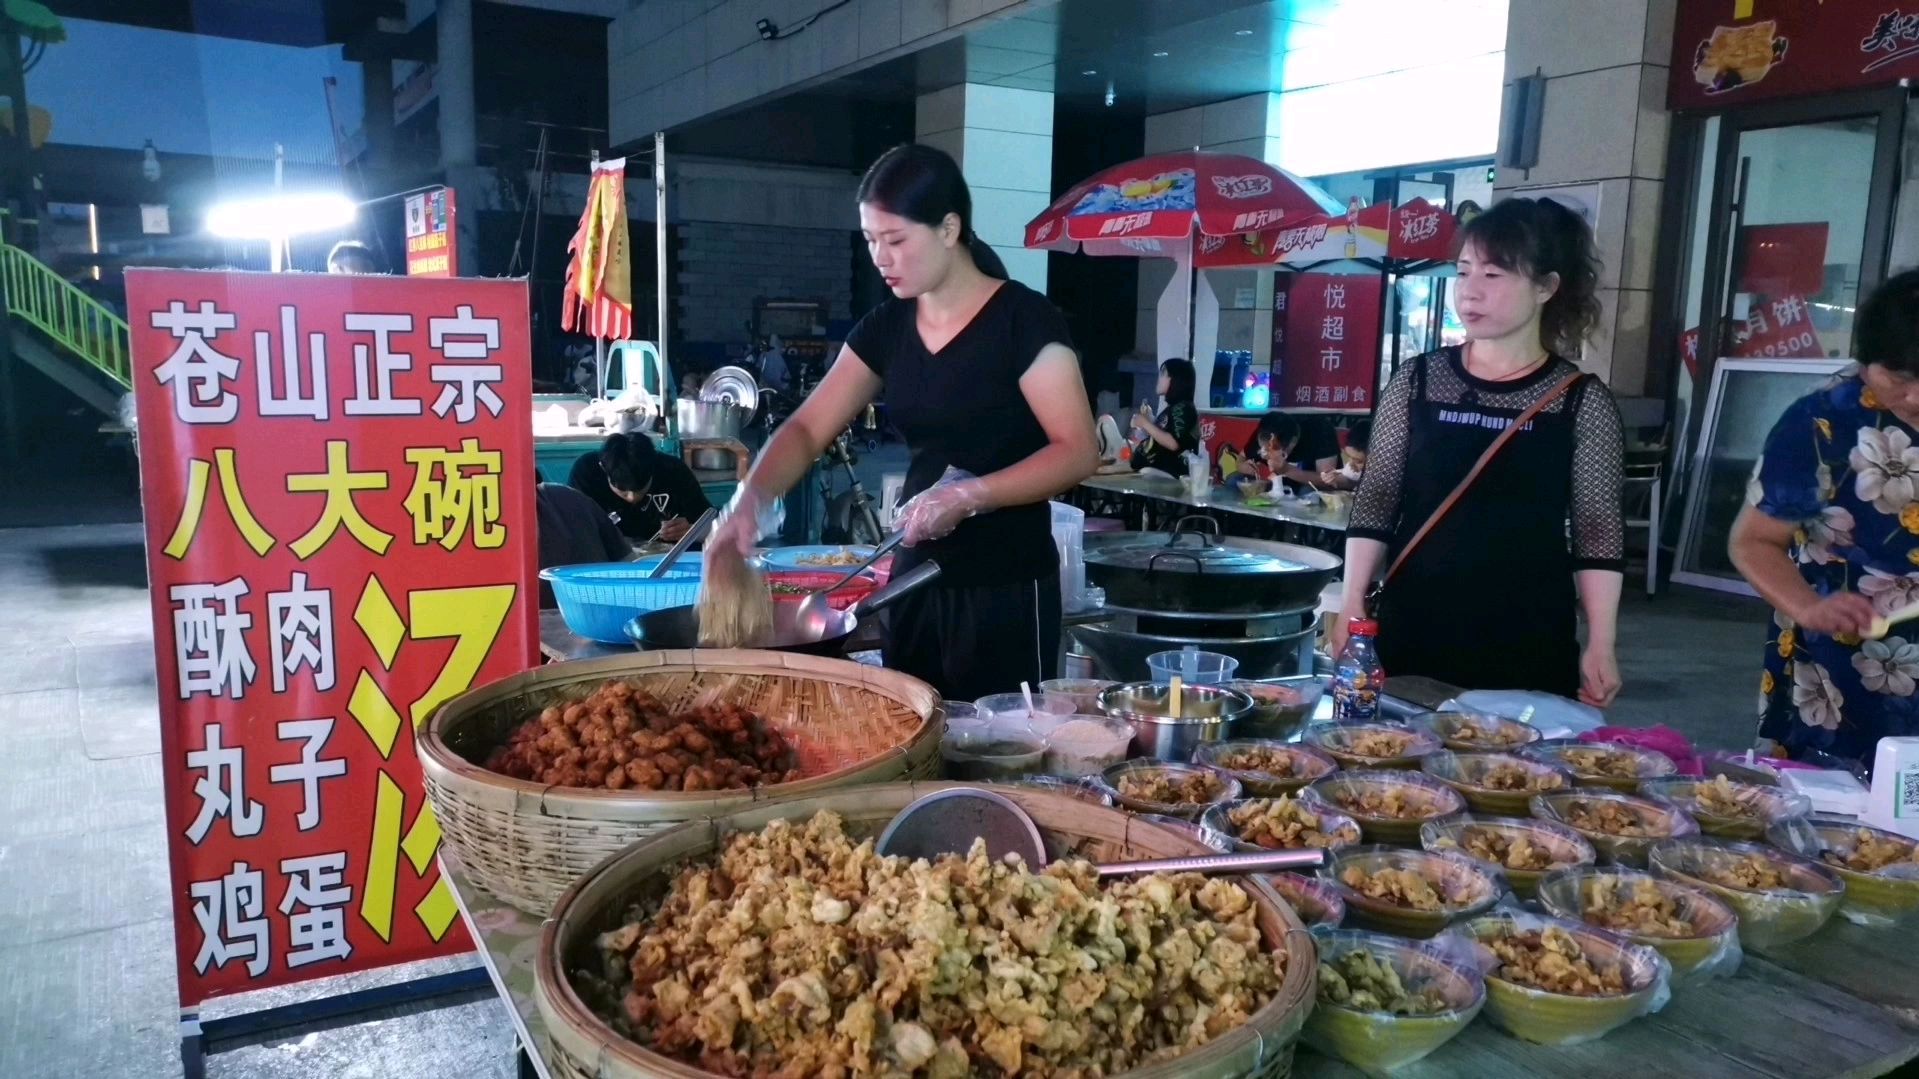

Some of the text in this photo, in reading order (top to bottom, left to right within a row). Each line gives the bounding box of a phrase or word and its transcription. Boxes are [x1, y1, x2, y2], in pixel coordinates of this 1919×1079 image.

[150, 300, 505, 424] 苍山正宗
[1296, 386, 1367, 403] 烟酒副食
[162, 437, 507, 562] 八大碗
[169, 571, 335, 700] 酥肉
[184, 715, 347, 846] 丸子
[190, 850, 353, 979] 鸡蛋
